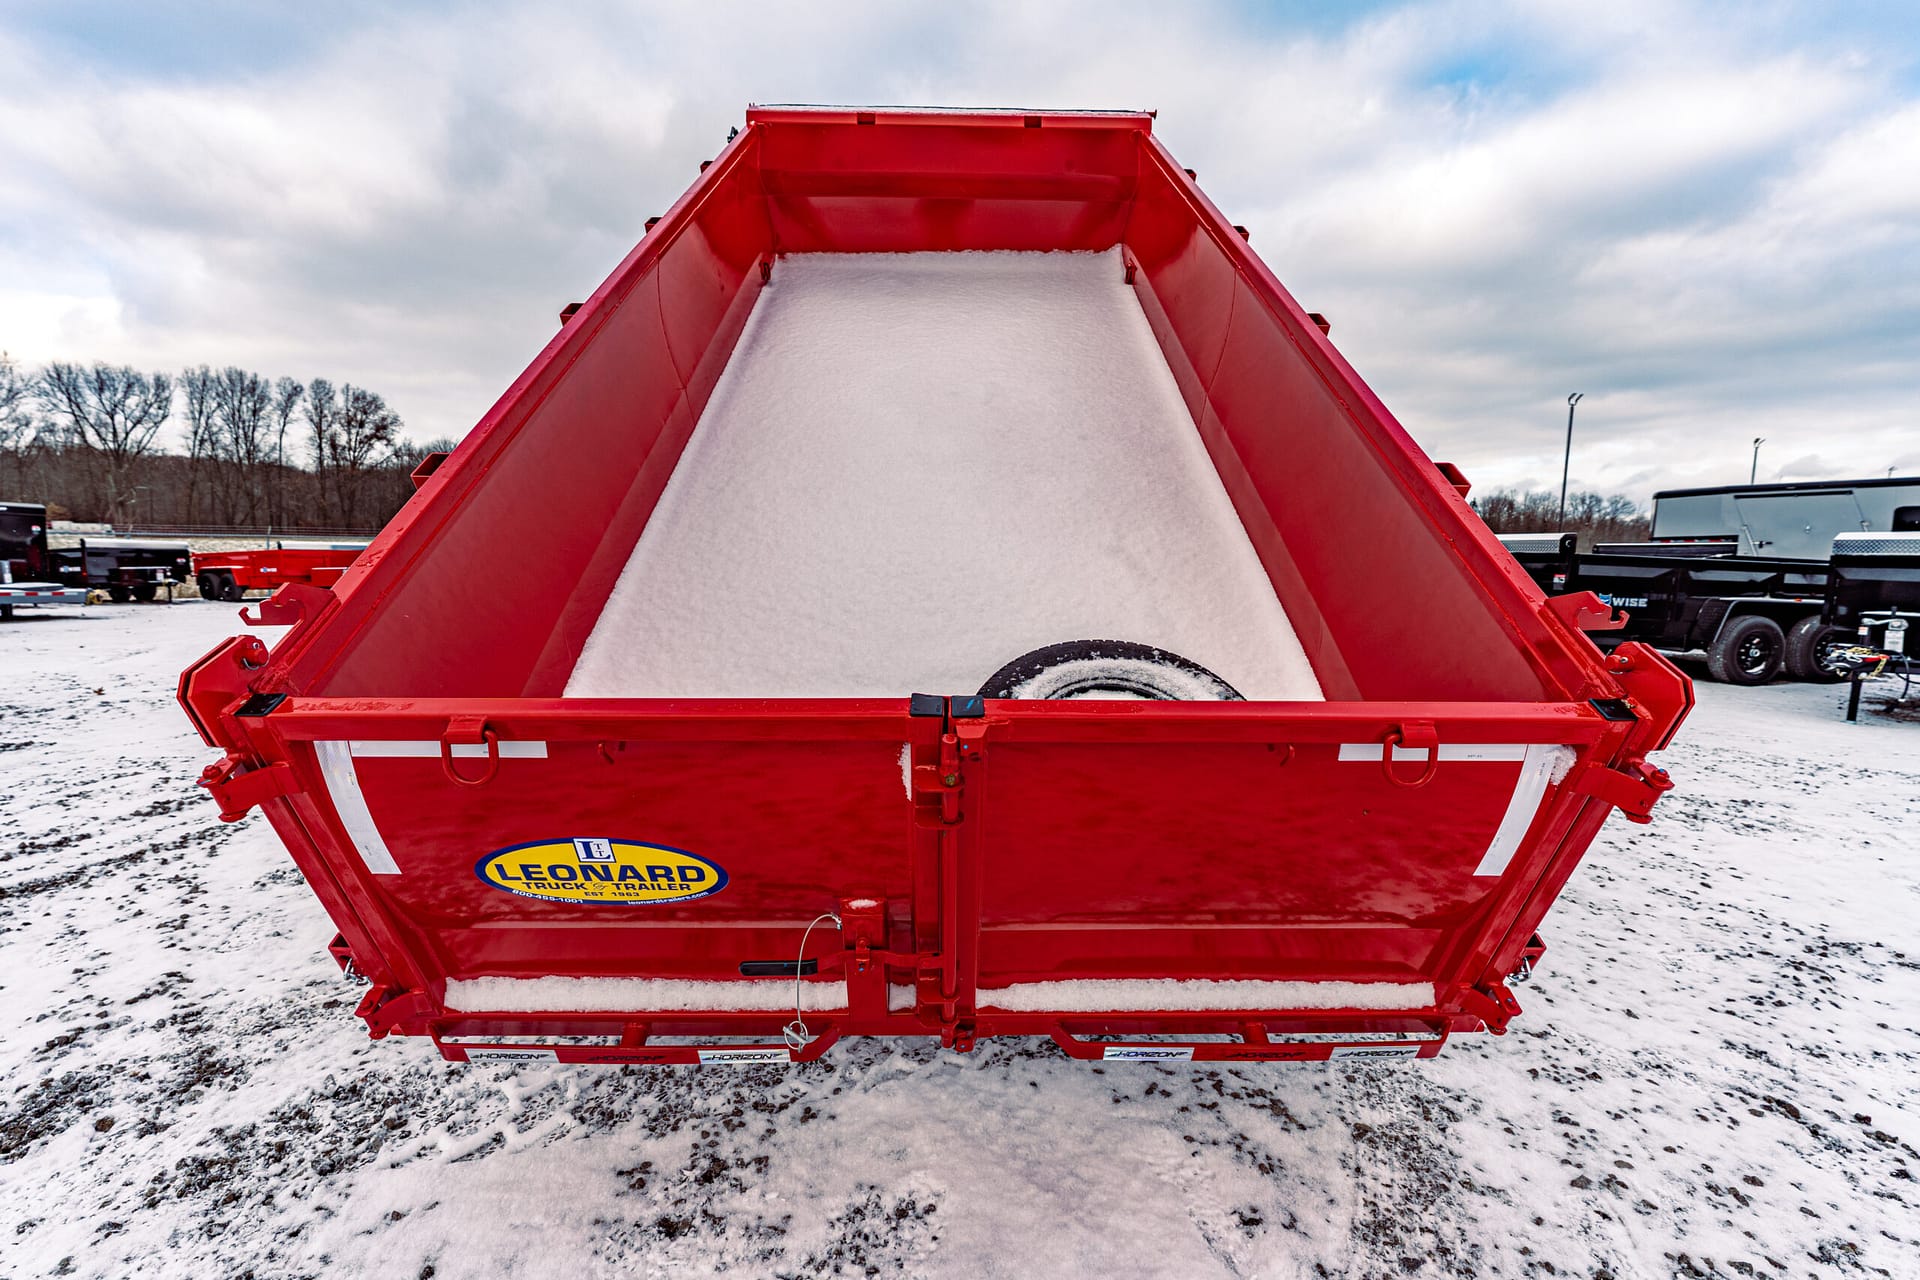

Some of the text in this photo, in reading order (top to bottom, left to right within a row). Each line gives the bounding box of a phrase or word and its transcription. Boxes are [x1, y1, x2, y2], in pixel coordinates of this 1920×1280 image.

[494, 863, 706, 883] LEONARD
[521, 882, 588, 890] TRUCK
[608, 882, 692, 891] TRAILER
[479, 1052, 541, 1060] HORIZON
[711, 1053, 774, 1061] HORIZON
